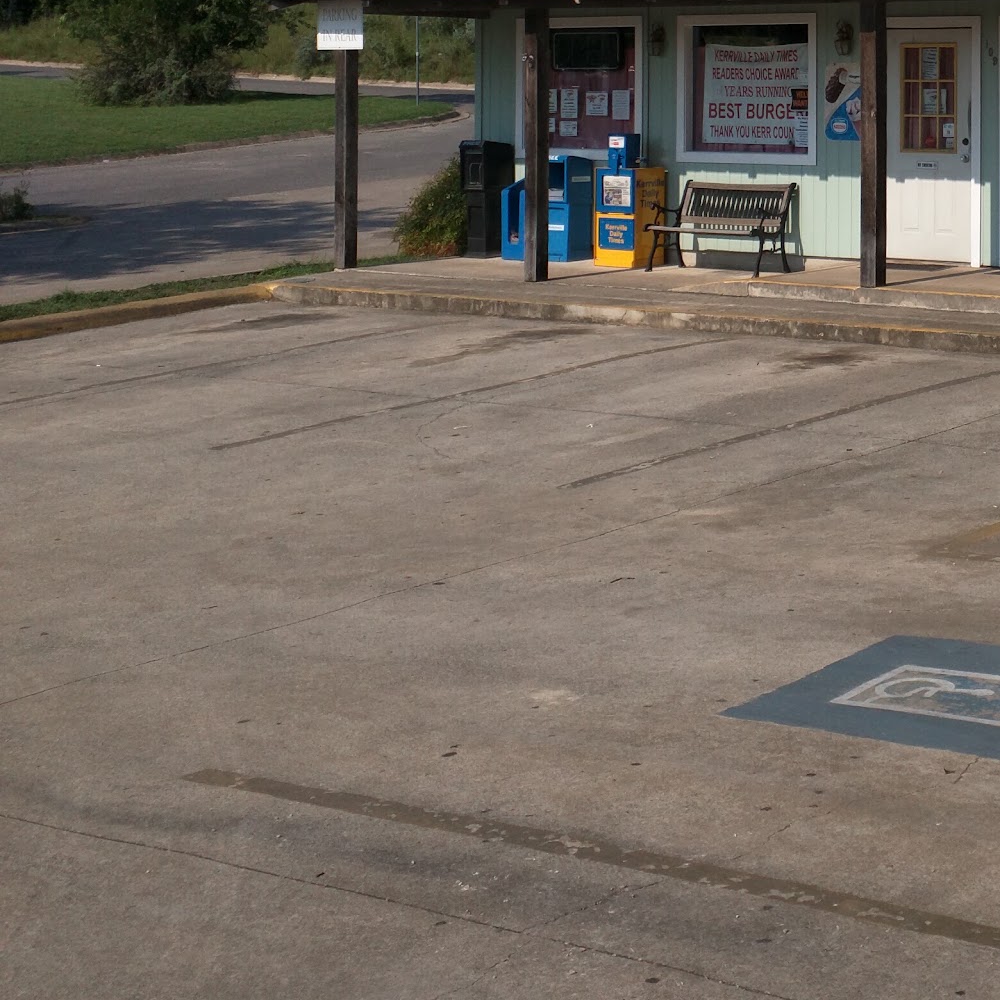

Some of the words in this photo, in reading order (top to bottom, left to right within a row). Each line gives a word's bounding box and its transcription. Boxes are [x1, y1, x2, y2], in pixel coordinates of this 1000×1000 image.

[322, 7, 358, 22] PARKING
[323, 28, 332, 42] IN
[334, 28, 357, 42] REAR
[714, 49, 753, 62] KERRVILLE
[753, 50, 775, 63] DAILY
[776, 49, 798, 62] TIMES
[712, 67, 744, 80] READERS
[745, 67, 772, 80] CHOICE
[724, 85, 753, 98] YEARS
[709, 102, 742, 119] BEST
[746, 103, 795, 119] BURGE
[710, 125, 734, 138] THANK
[735, 125, 750, 138] YOU
[751, 126, 771, 139] KERR
[772, 126, 795, 139] COUN
[605, 223, 628, 231] Kerrville
[609, 230, 624, 239] Daily
